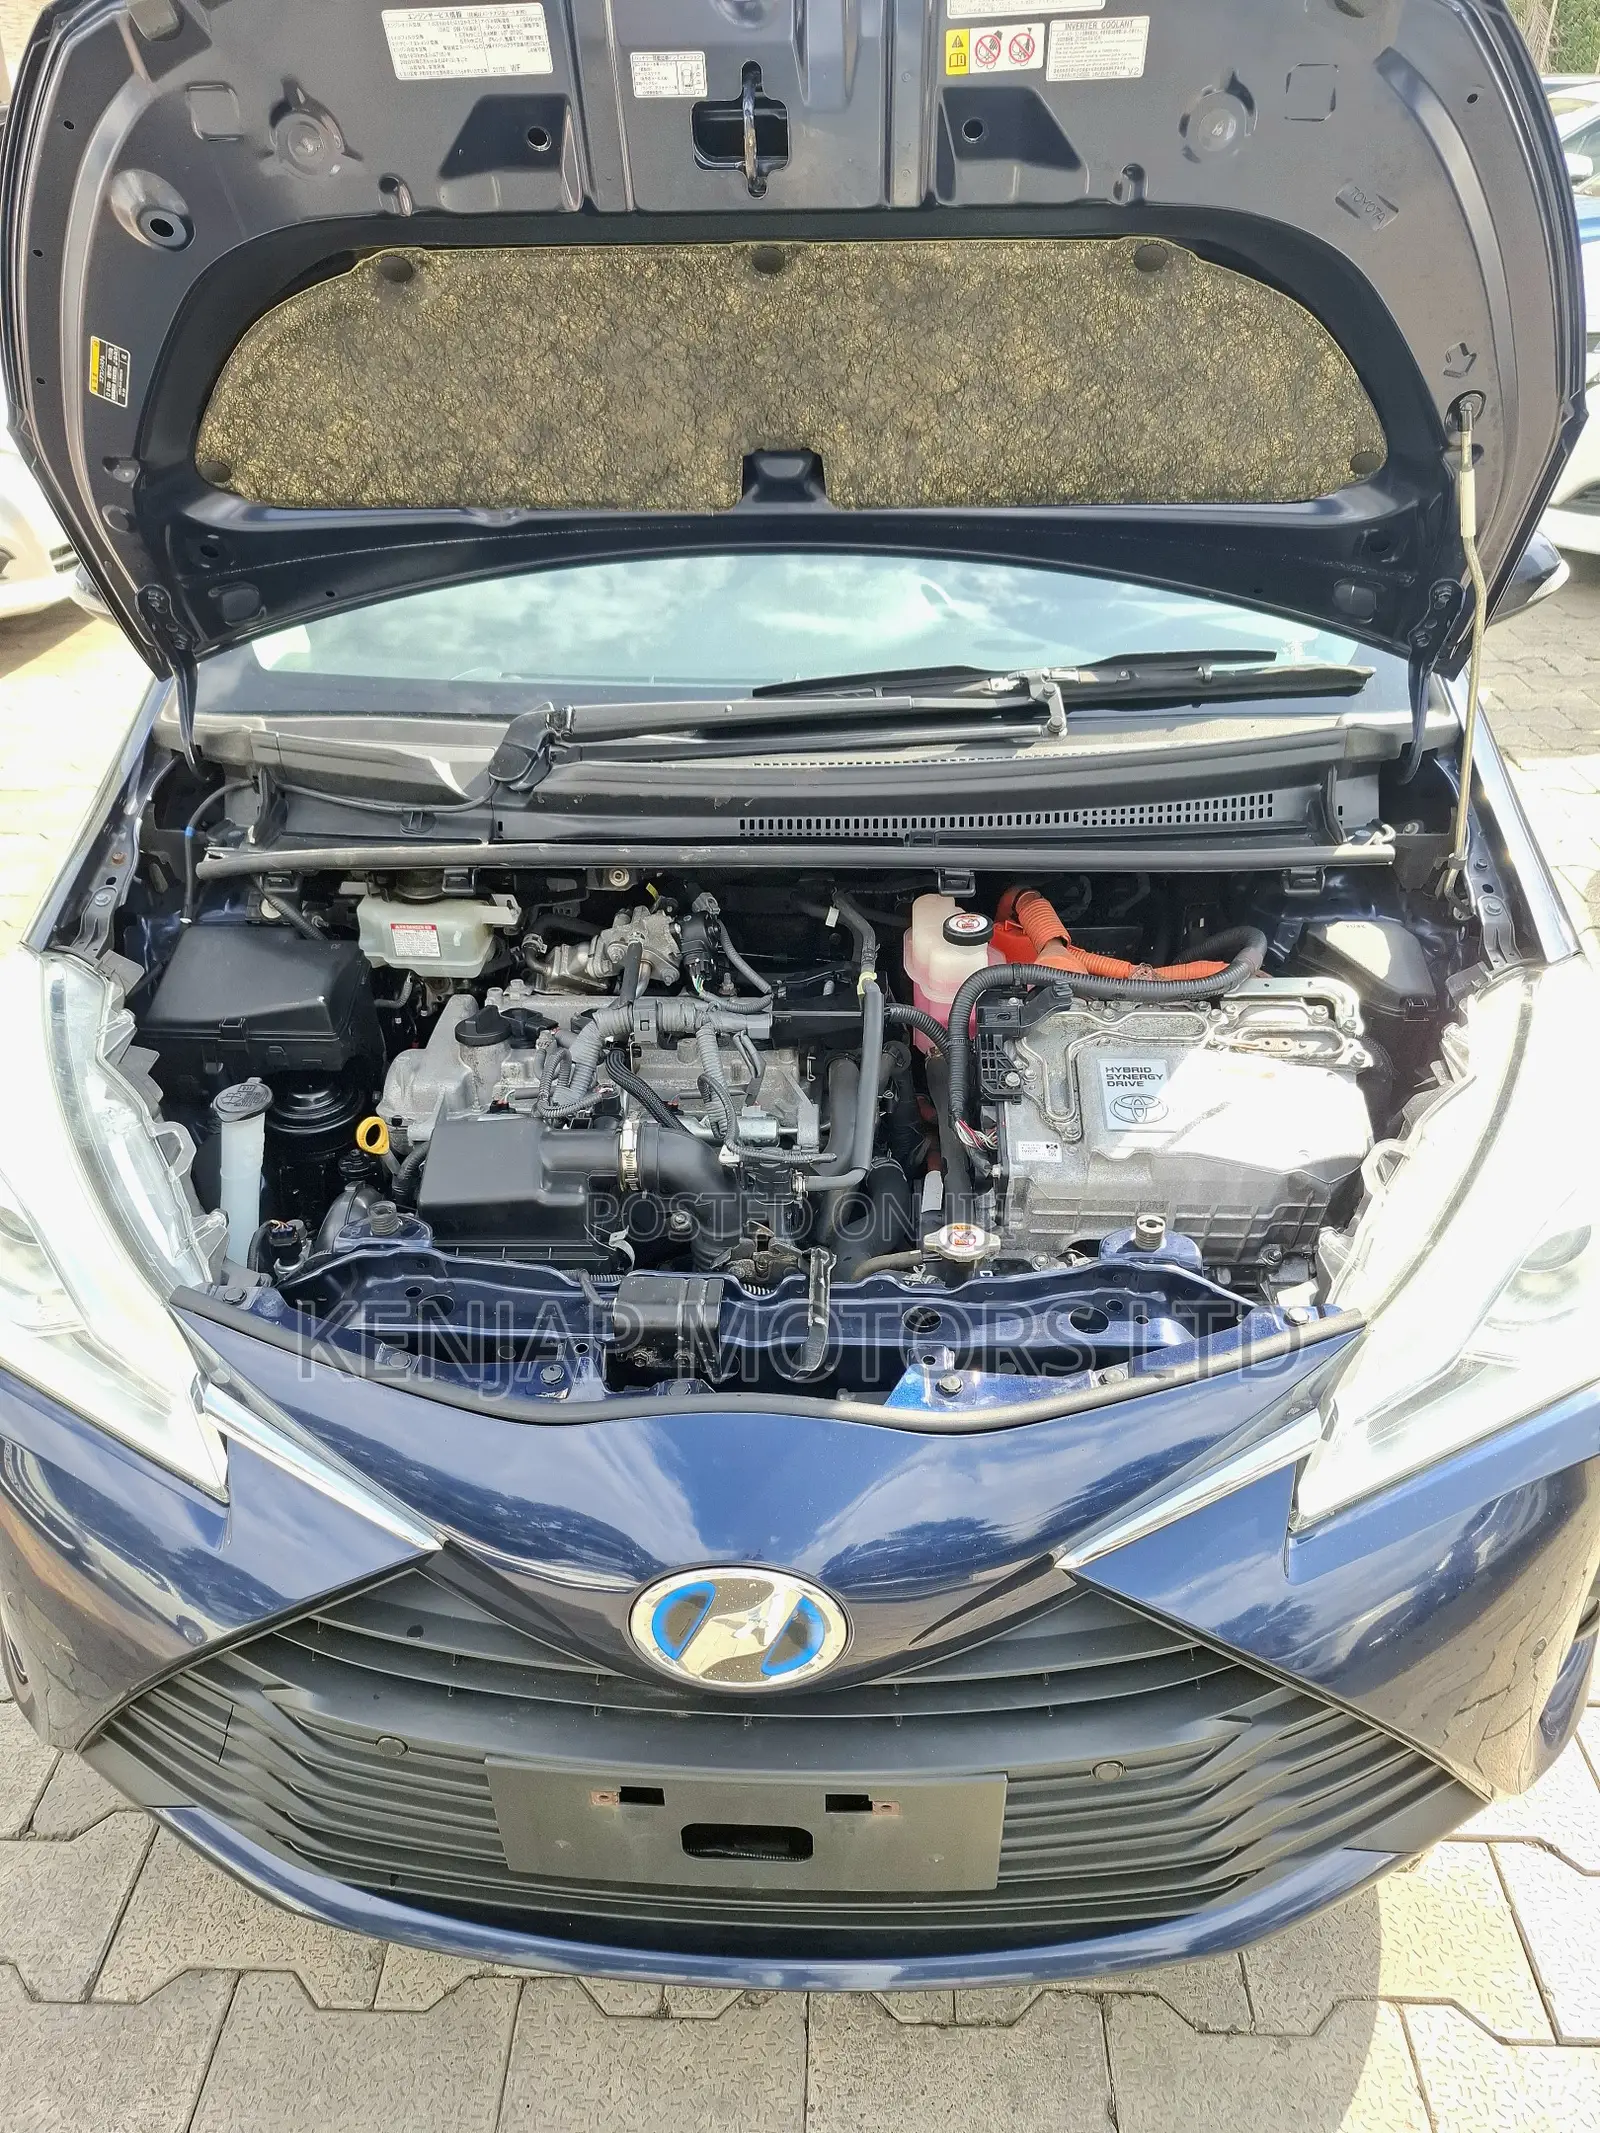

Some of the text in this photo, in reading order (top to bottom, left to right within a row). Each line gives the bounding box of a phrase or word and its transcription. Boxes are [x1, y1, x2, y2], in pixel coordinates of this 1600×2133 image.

[1065, 20, 1134, 31] INVERTER COOLANT
[1127, 67, 1140, 76] V2
[1350, 186, 1386, 225] TOYOTA
